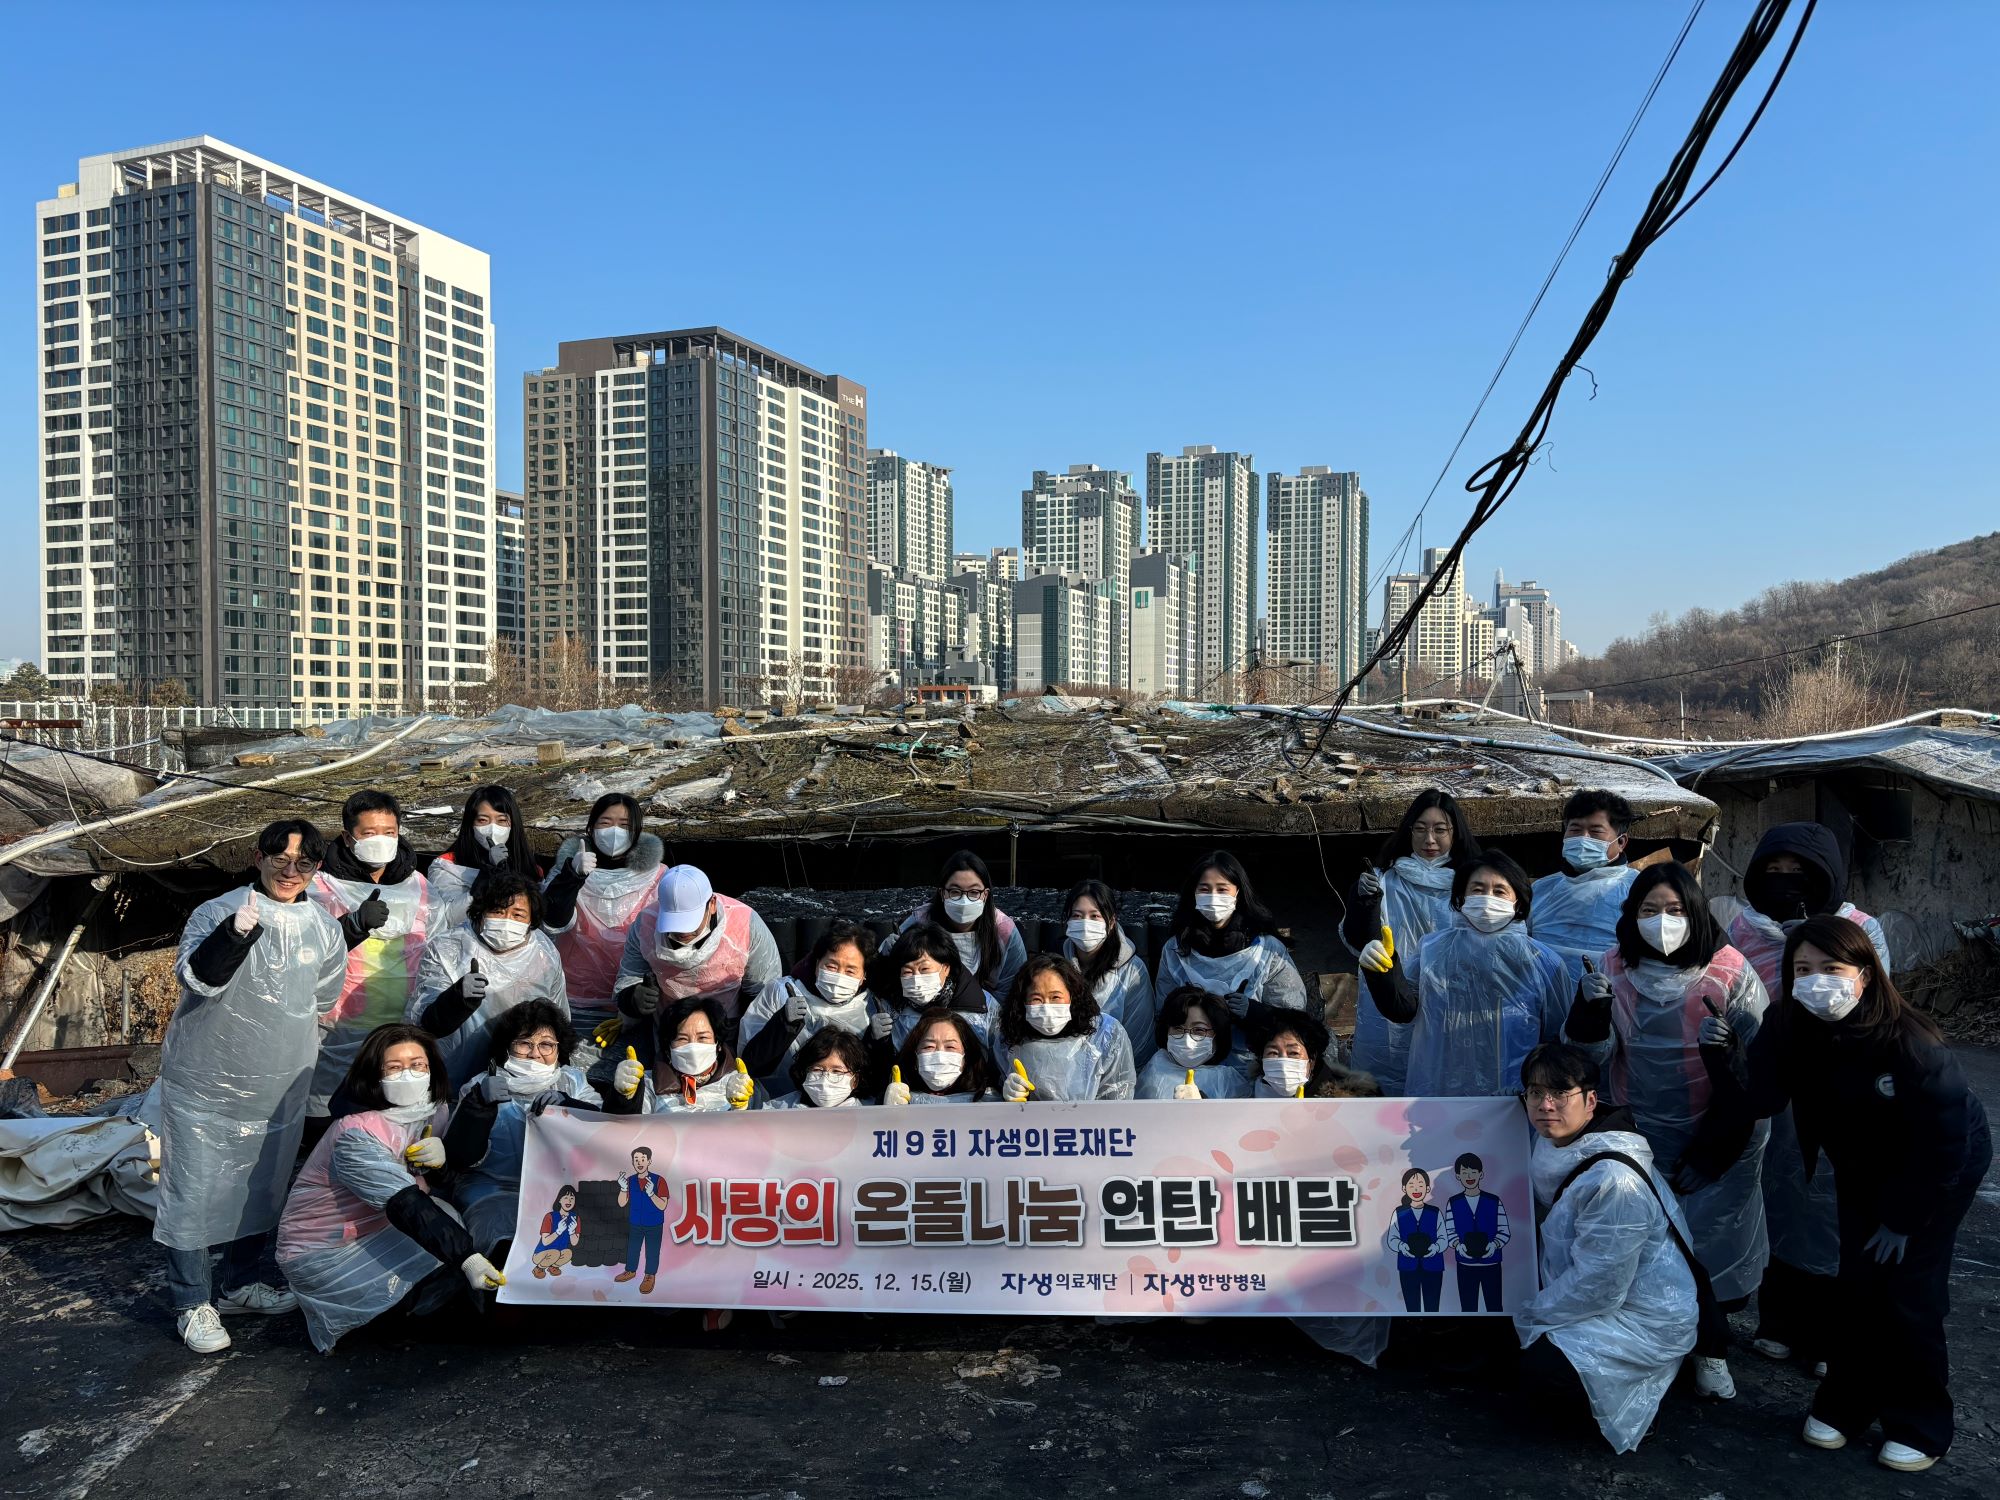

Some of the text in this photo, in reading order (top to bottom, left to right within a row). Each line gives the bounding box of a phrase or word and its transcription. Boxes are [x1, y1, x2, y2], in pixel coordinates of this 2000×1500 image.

[841, 393, 864, 408] THE H
[968, 1128, 1137, 1158] 자생의료재단
[671, 1177, 1358, 1247] 사랑의 온돌나눔 연탄 배달
[753, 1270, 789, 1290] 일시
[812, 1272, 865, 1292] 2025.
[874, 1272, 901, 1292] 12.
[910, 1270, 973, 1294] 15.(월)
[1000, 1272, 1118, 1296] 자생의료재단
[1143, 1272, 1267, 1296] 자생한방병원
